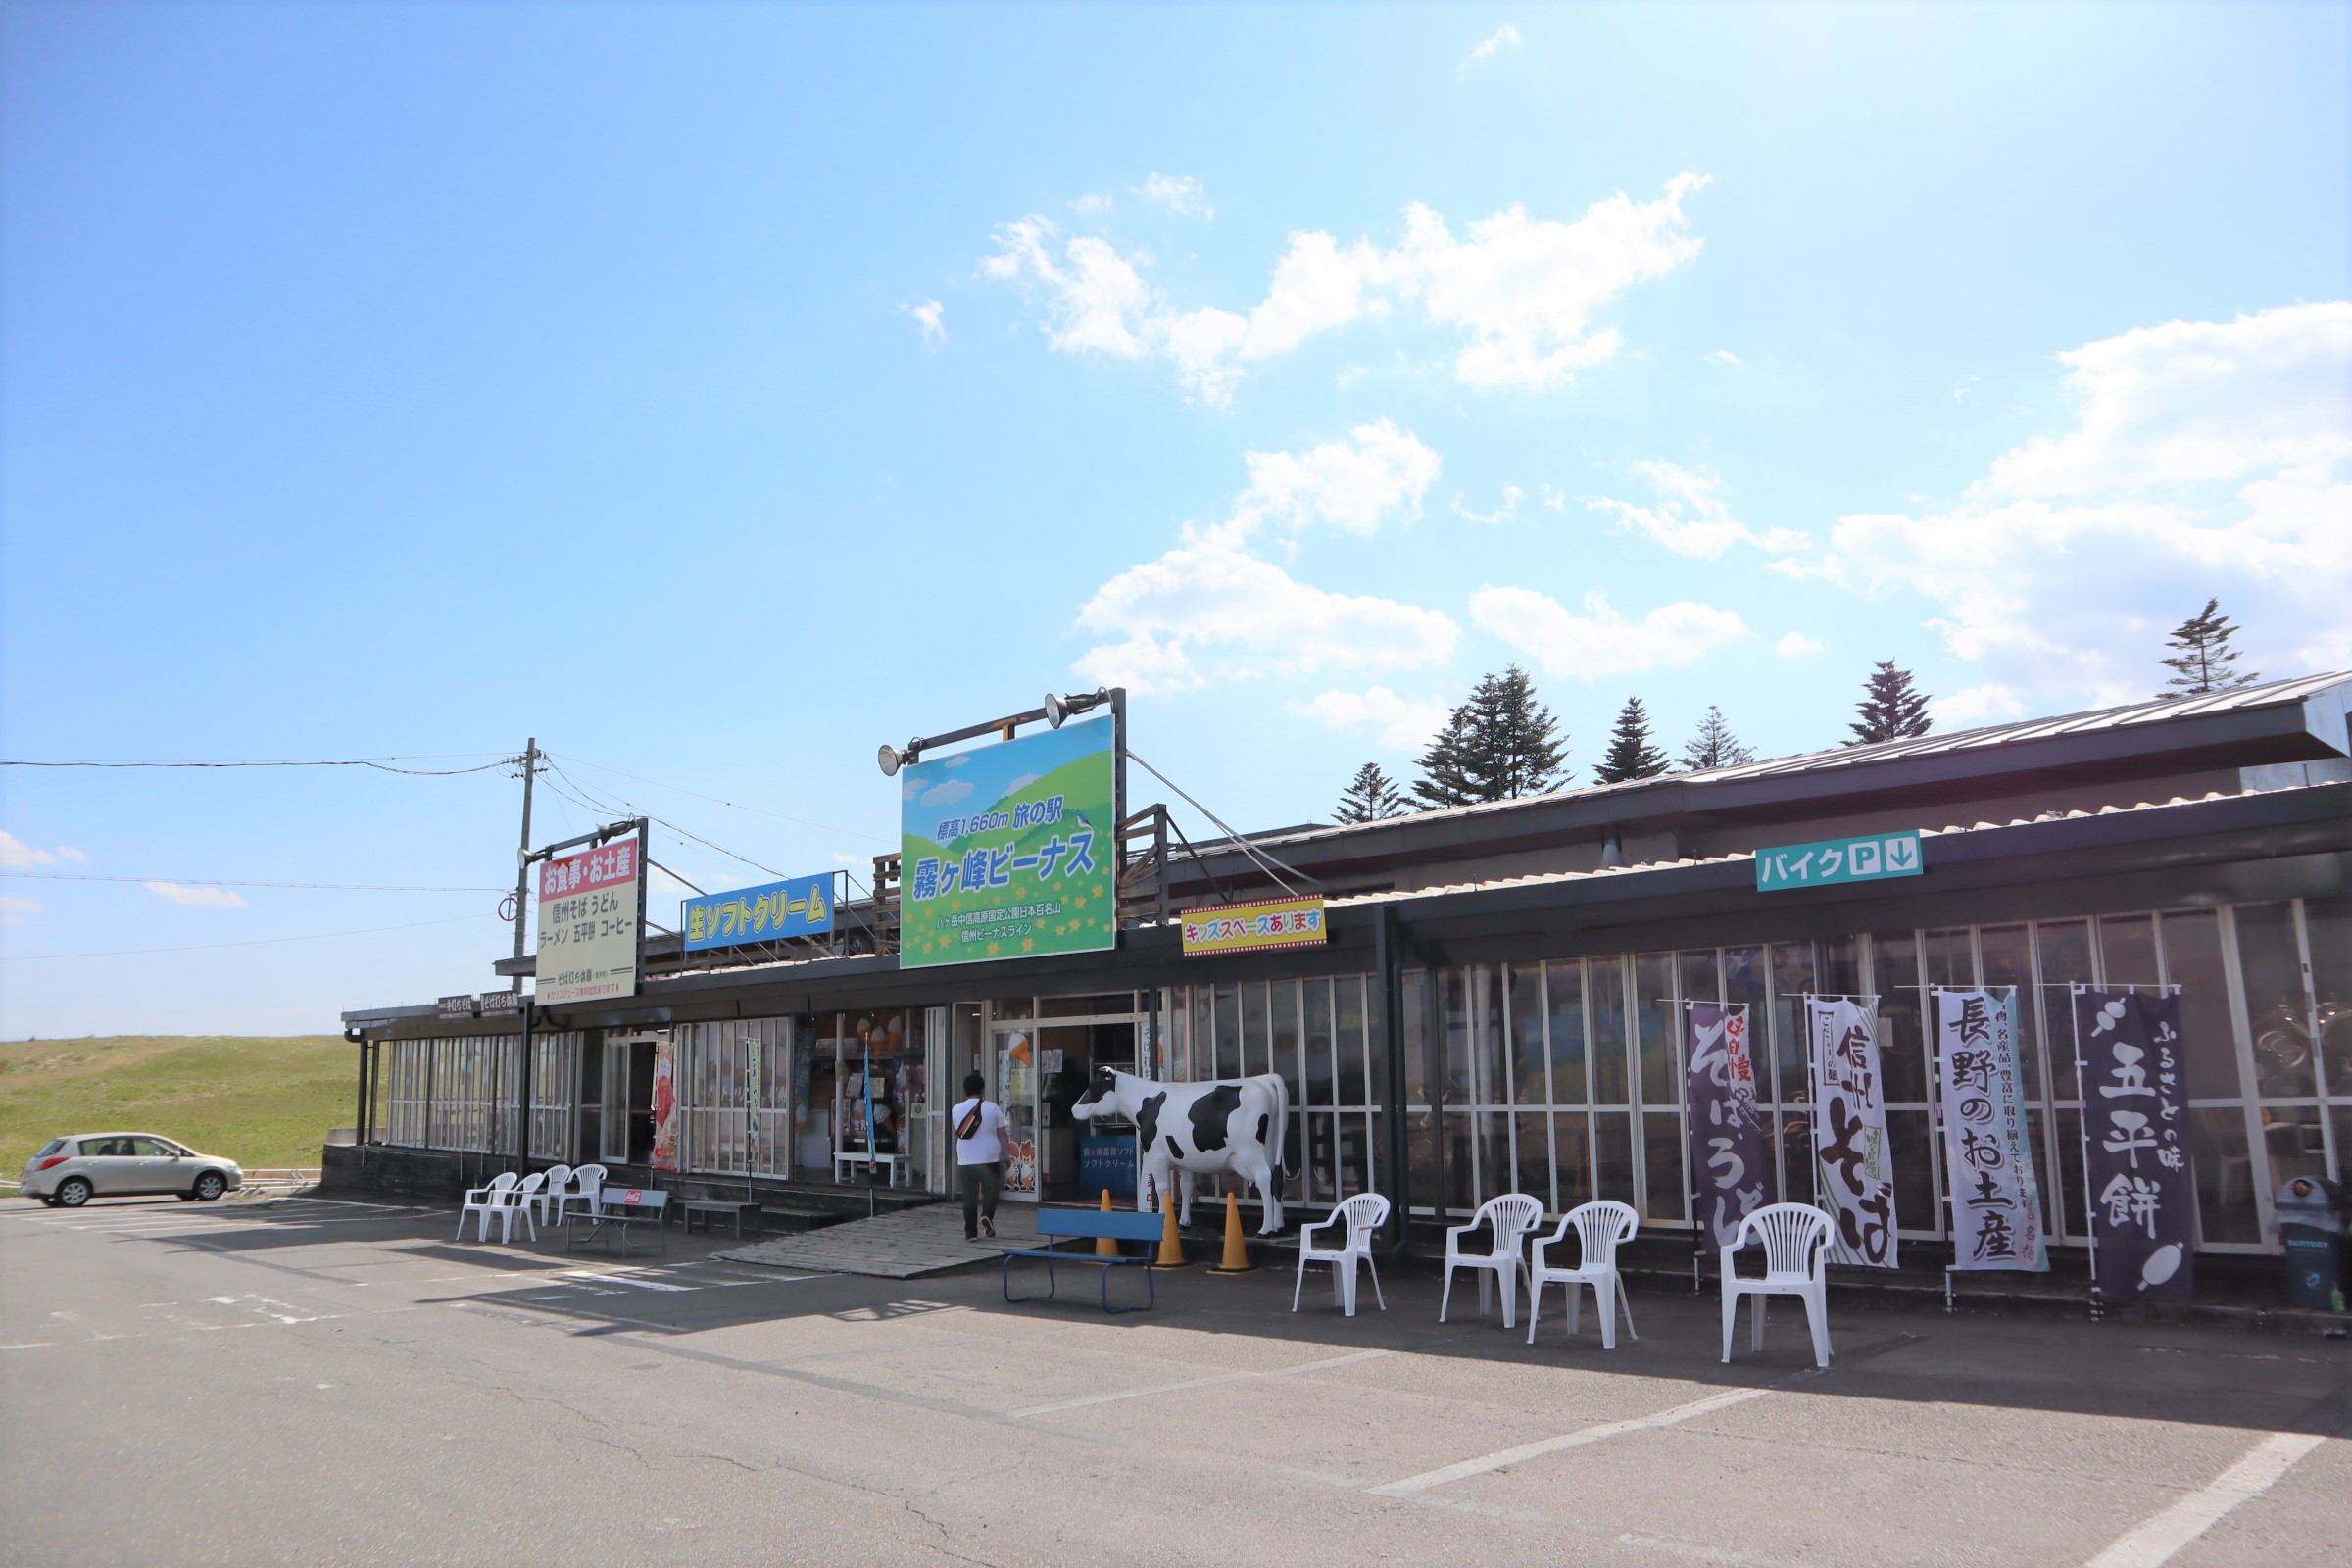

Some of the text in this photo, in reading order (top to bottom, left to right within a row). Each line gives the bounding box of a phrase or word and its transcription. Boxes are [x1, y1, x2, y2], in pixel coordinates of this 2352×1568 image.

[937, 796, 1063, 841] 標高1,660m 旅の駅
[544, 846, 631, 895] お食事・お土産
[1761, 849, 1843, 883] バイク
[553, 891, 619, 924] 信州そば うどん
[688, 883, 827, 942] 生ソフトクリーム
[1185, 909, 1321, 942] キッズスペースあります
[540, 916, 632, 949] ラーメン 五平餅 コーヒー
[961, 924, 1032, 943] 信州ビーナスライン
[2154, 1021, 2184, 1173] ふるさとの味
[1947, 996, 2016, 1258] 長野のお土産
[2098, 1042, 2162, 1240] 五平餅
[1083, 1159, 1135, 1168] ソフトクリーム
